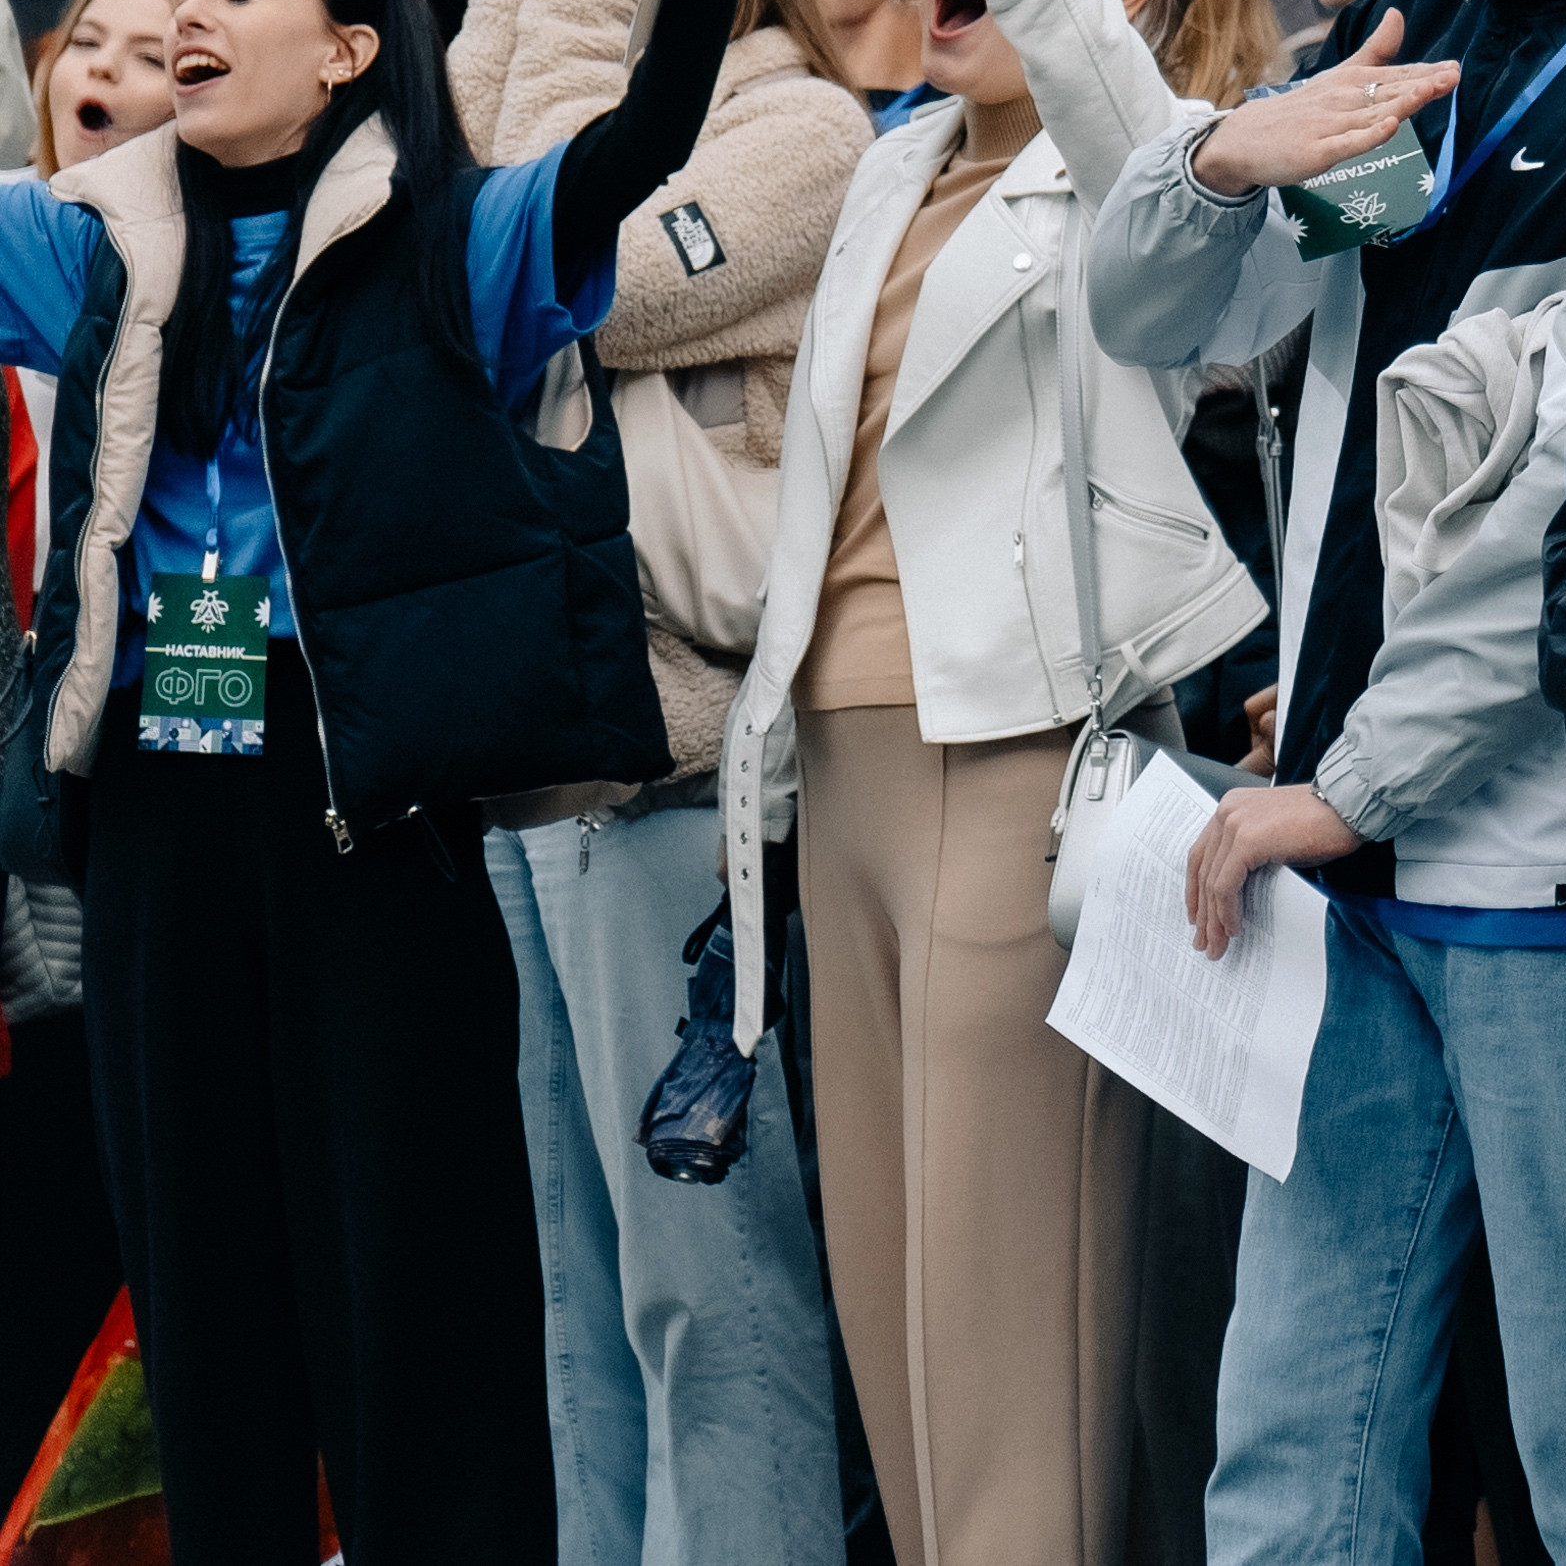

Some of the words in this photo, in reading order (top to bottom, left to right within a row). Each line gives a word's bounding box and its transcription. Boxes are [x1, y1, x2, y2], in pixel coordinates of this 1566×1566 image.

[1302, 154, 1400, 190] НАСТАВНИК
[165, 644, 246, 660] НАСТАВНИК
[155, 667, 253, 707] ФГО
